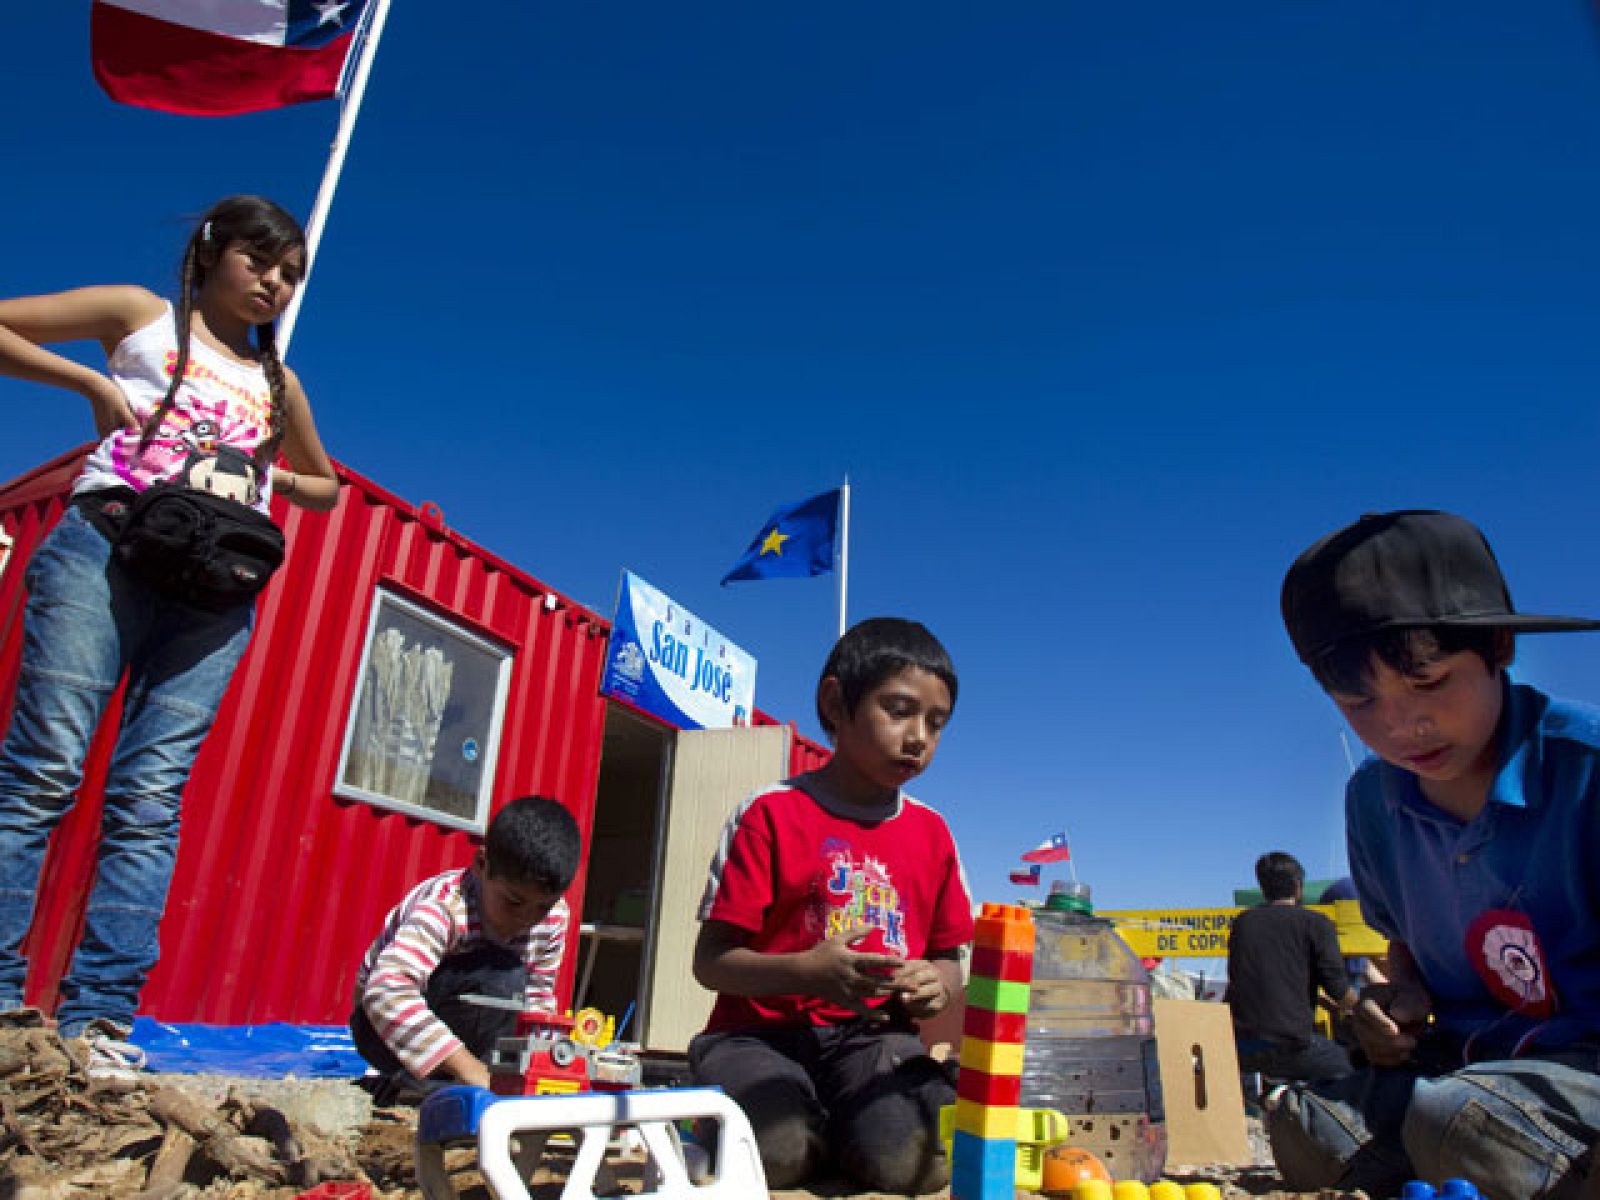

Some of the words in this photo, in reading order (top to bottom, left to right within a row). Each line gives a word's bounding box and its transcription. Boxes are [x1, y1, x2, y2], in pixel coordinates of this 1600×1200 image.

[650, 620, 689, 680] San
[690, 647, 733, 703] José
[1157, 934, 1178, 951] DE
